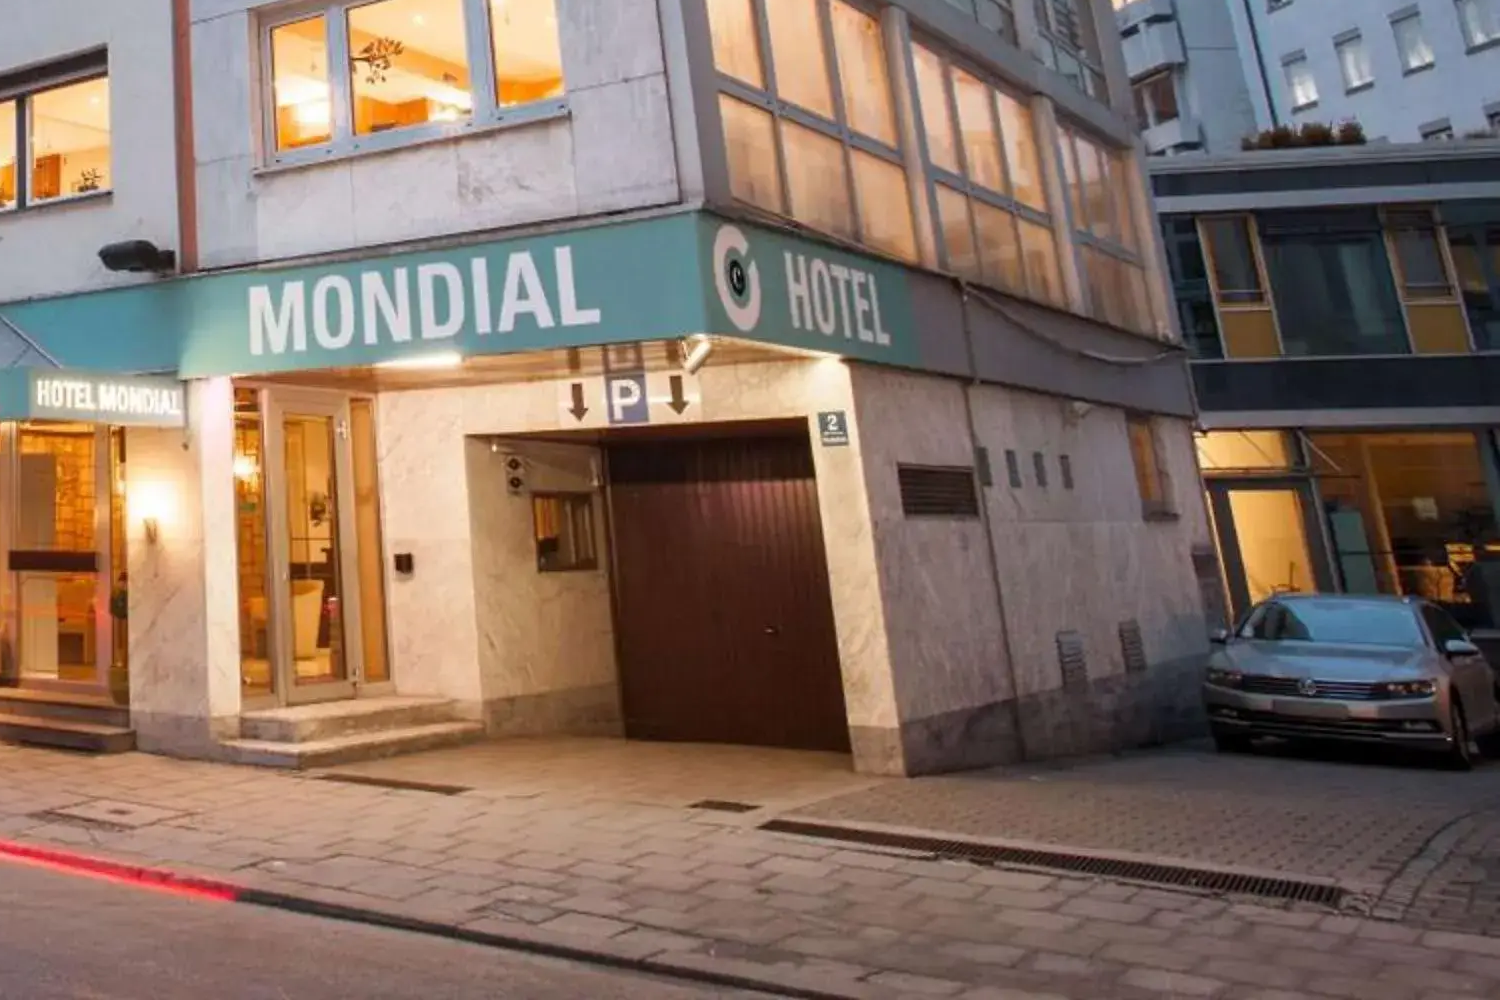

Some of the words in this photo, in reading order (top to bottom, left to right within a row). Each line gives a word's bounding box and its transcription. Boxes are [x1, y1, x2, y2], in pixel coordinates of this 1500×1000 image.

[248, 245, 601, 356] MONDIAL
[784, 251, 892, 346] HOTEL
[36, 379, 97, 411] HOTEL
[99, 383, 182, 415] MONDIAL
[611, 379, 641, 421] P
[827, 414, 839, 431] 2
